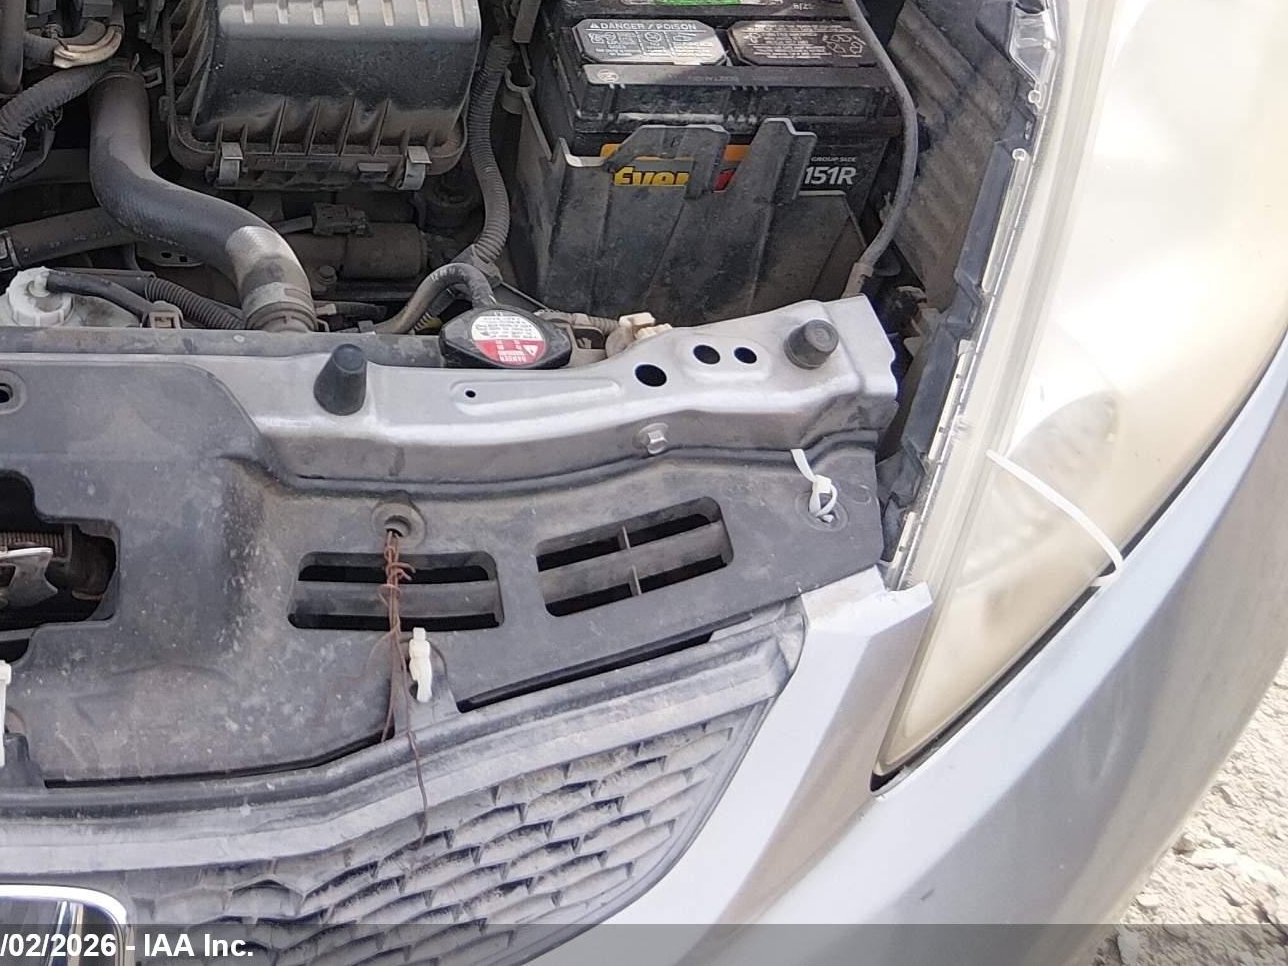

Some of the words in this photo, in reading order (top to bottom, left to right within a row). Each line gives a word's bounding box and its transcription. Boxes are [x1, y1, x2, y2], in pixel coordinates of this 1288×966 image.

[600, 22, 645, 31] DANGER
[657, 22, 697, 31] POISON
[804, 166, 856, 185] 151R
